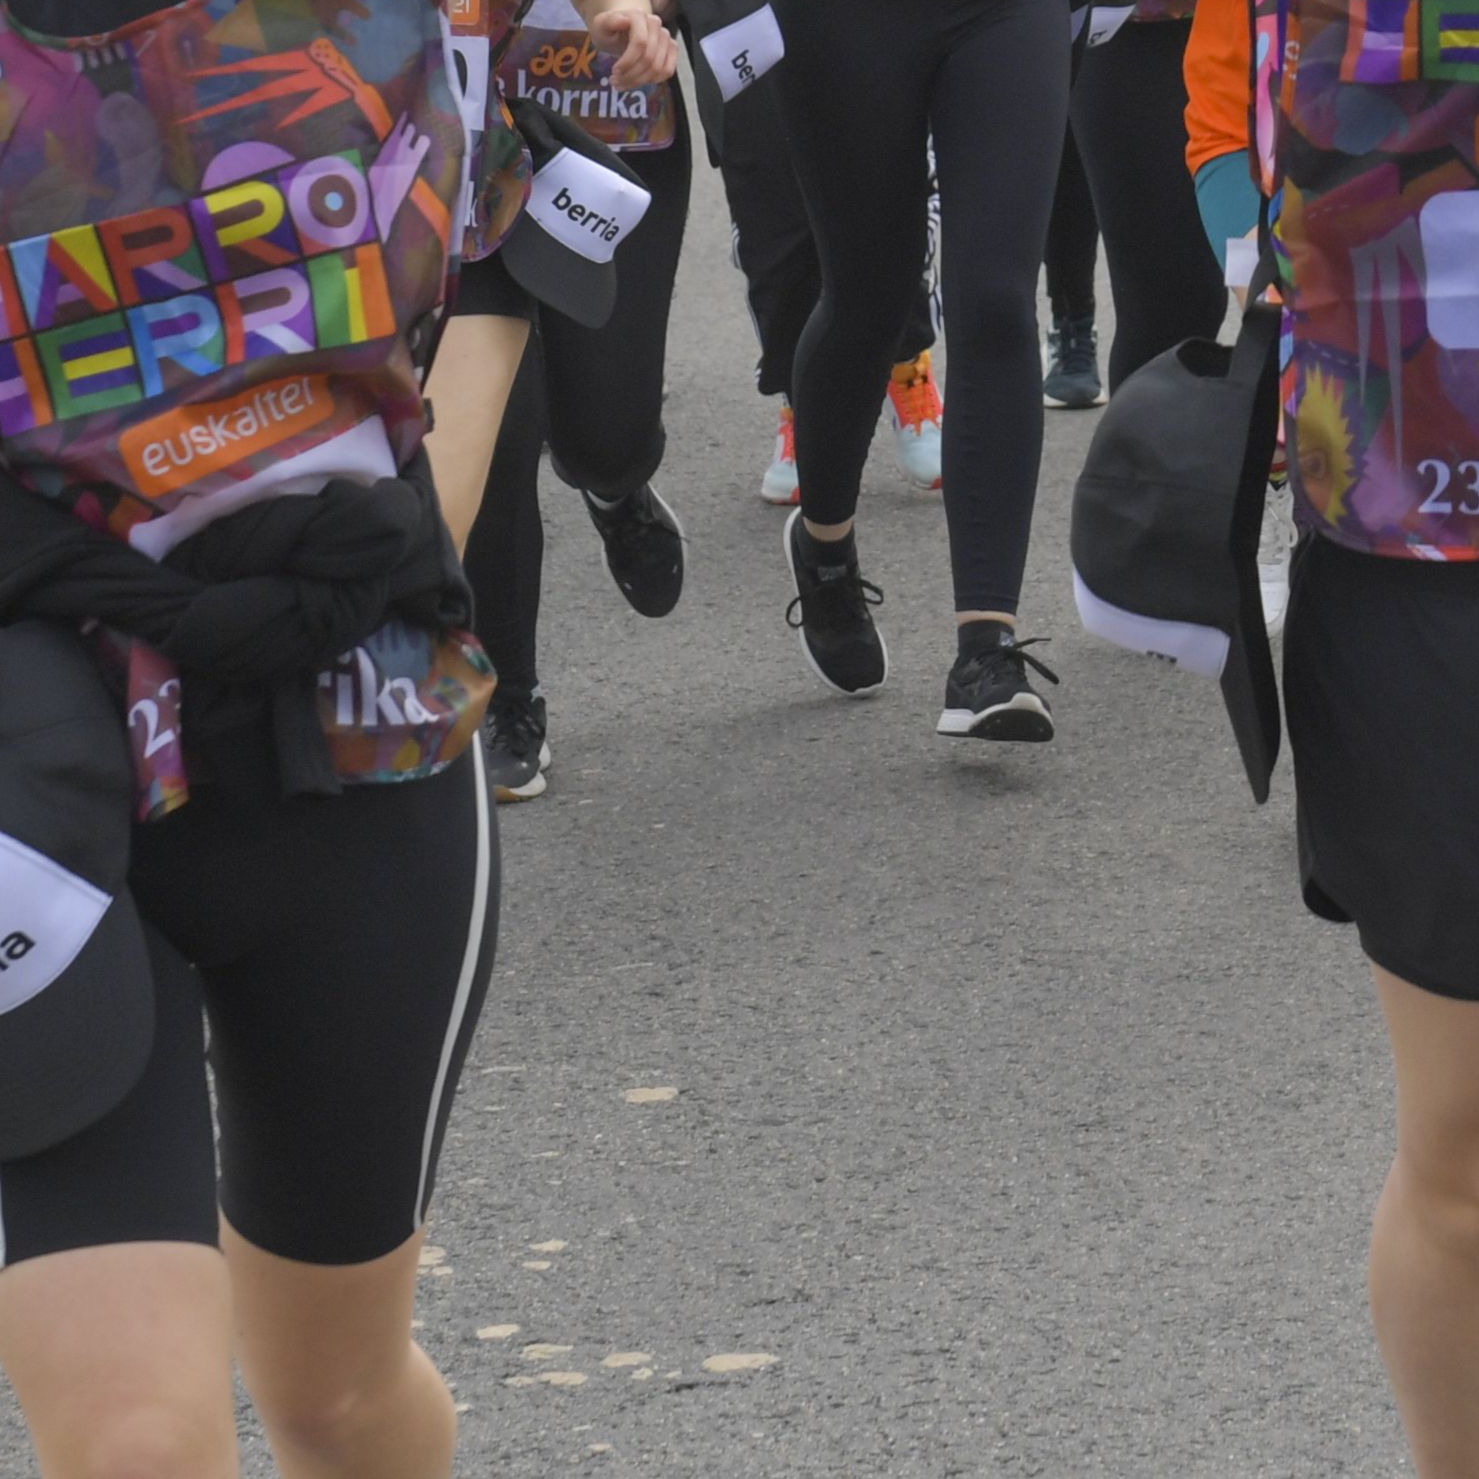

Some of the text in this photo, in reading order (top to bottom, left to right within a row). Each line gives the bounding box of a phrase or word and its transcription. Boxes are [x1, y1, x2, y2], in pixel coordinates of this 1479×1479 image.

[530, 35, 598, 80] aek
[731, 49, 758, 85] ber
[551, 187, 621, 243] berria
